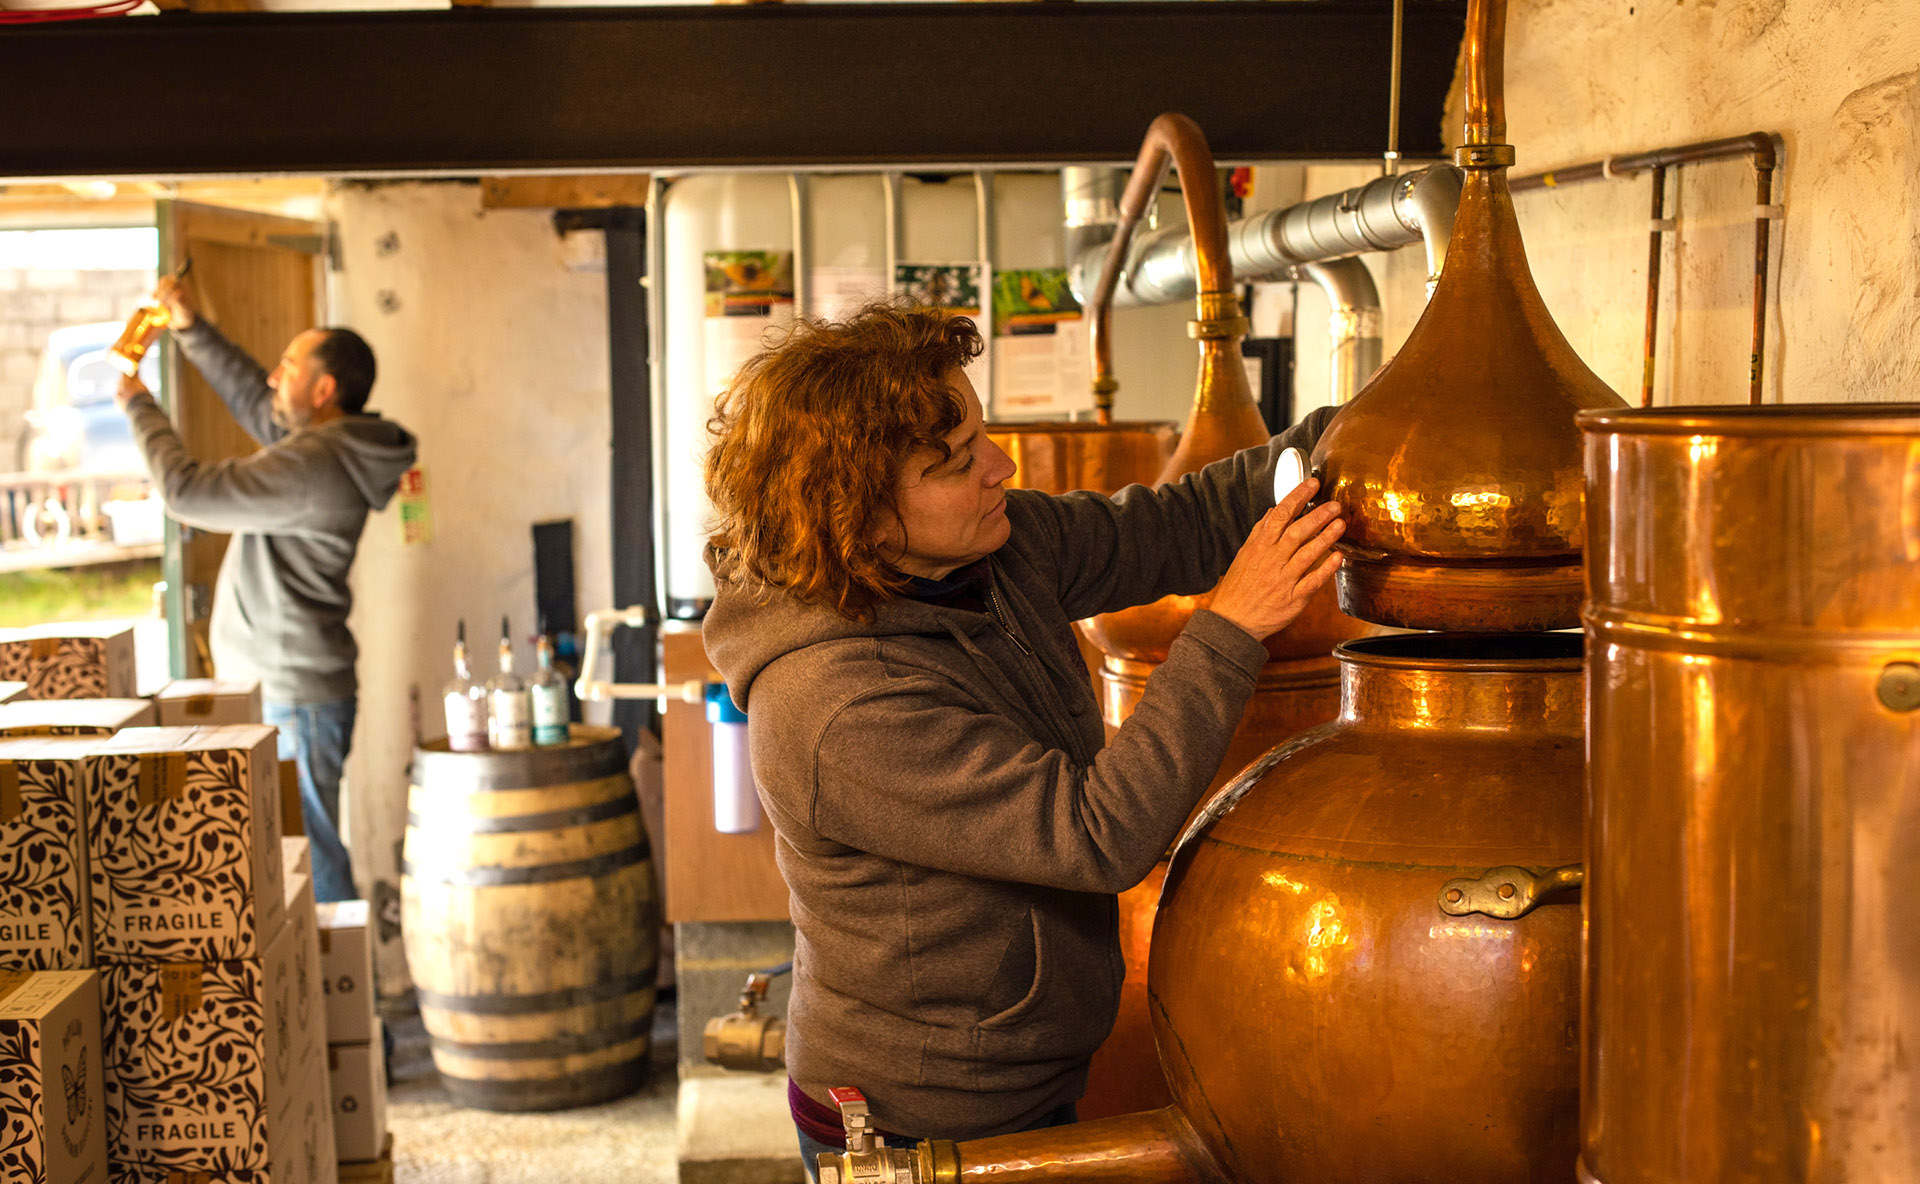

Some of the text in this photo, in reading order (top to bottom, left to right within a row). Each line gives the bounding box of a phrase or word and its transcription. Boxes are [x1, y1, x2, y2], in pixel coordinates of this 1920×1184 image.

[124, 912, 223, 932] FRAGILE
[0, 923, 51, 941] GILE
[137, 1122, 236, 1141] FRAGILE
